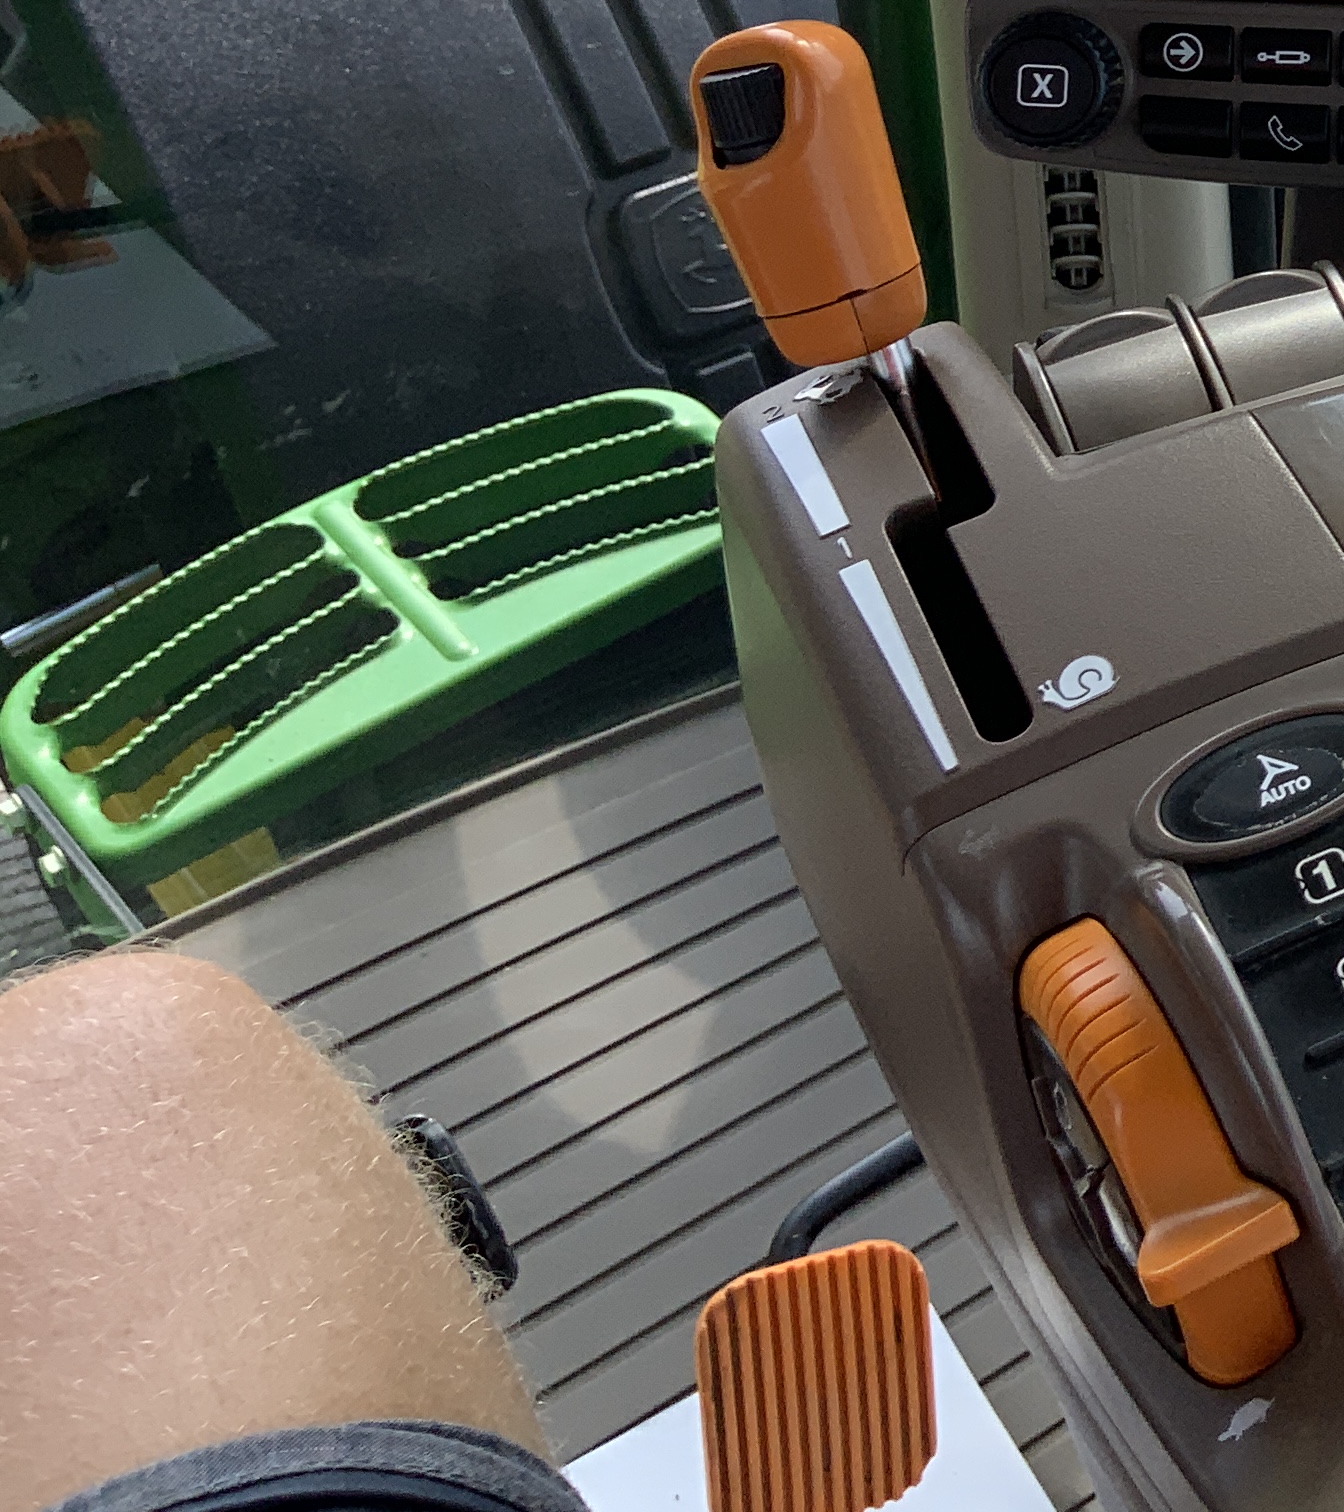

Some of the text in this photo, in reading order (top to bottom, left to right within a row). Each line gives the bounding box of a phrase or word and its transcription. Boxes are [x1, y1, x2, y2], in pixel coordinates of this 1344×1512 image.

[1031, 73, 1054, 99] X
[762, 406, 785, 424] 2
[1259, 774, 1312, 809] AUTO
[1311, 859, 1338, 892] 1
